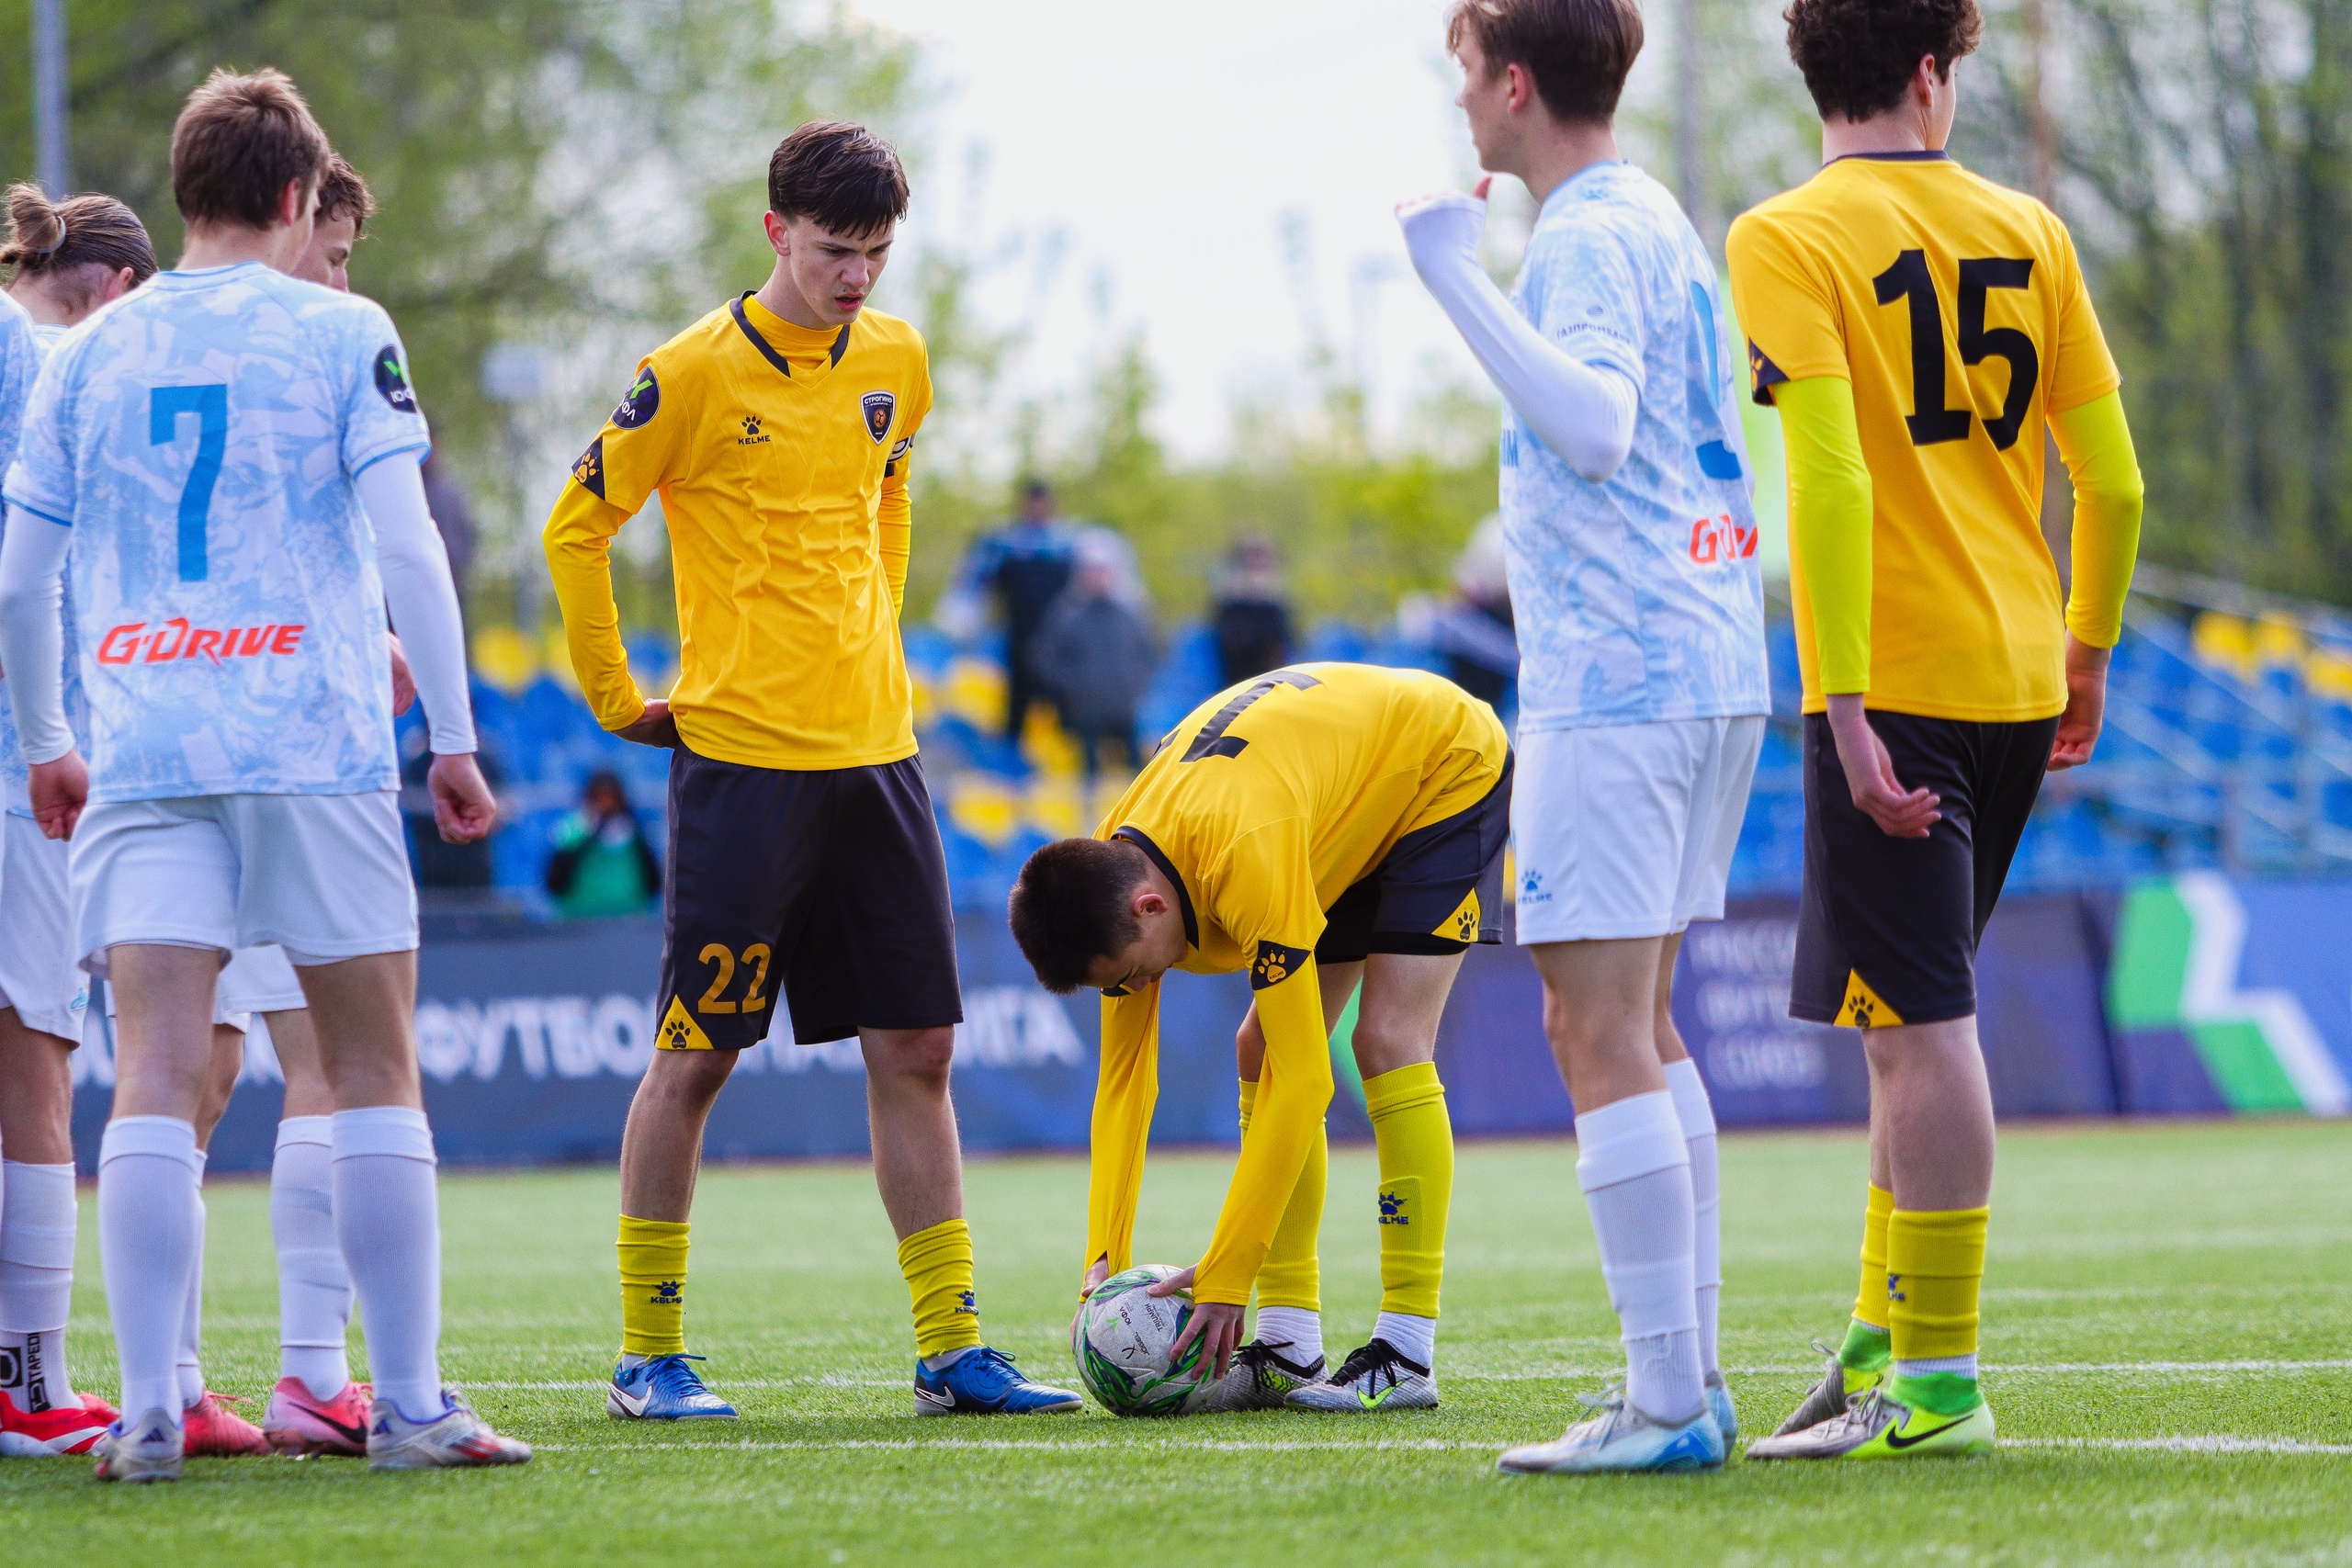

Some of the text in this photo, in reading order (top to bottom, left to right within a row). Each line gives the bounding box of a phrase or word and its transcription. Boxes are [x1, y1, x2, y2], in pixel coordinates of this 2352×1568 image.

[1872, 248, 2039, 452] 15
[864, 395, 893, 404] СТРОГИНО
[738, 434, 771, 446] KELME
[150, 383, 228, 582] 7
[697, 942, 771, 1014] 22
[1120, 1306, 1132, 1325] ЮФЛ
[1145, 1303, 1163, 1332] TRIUMPH
